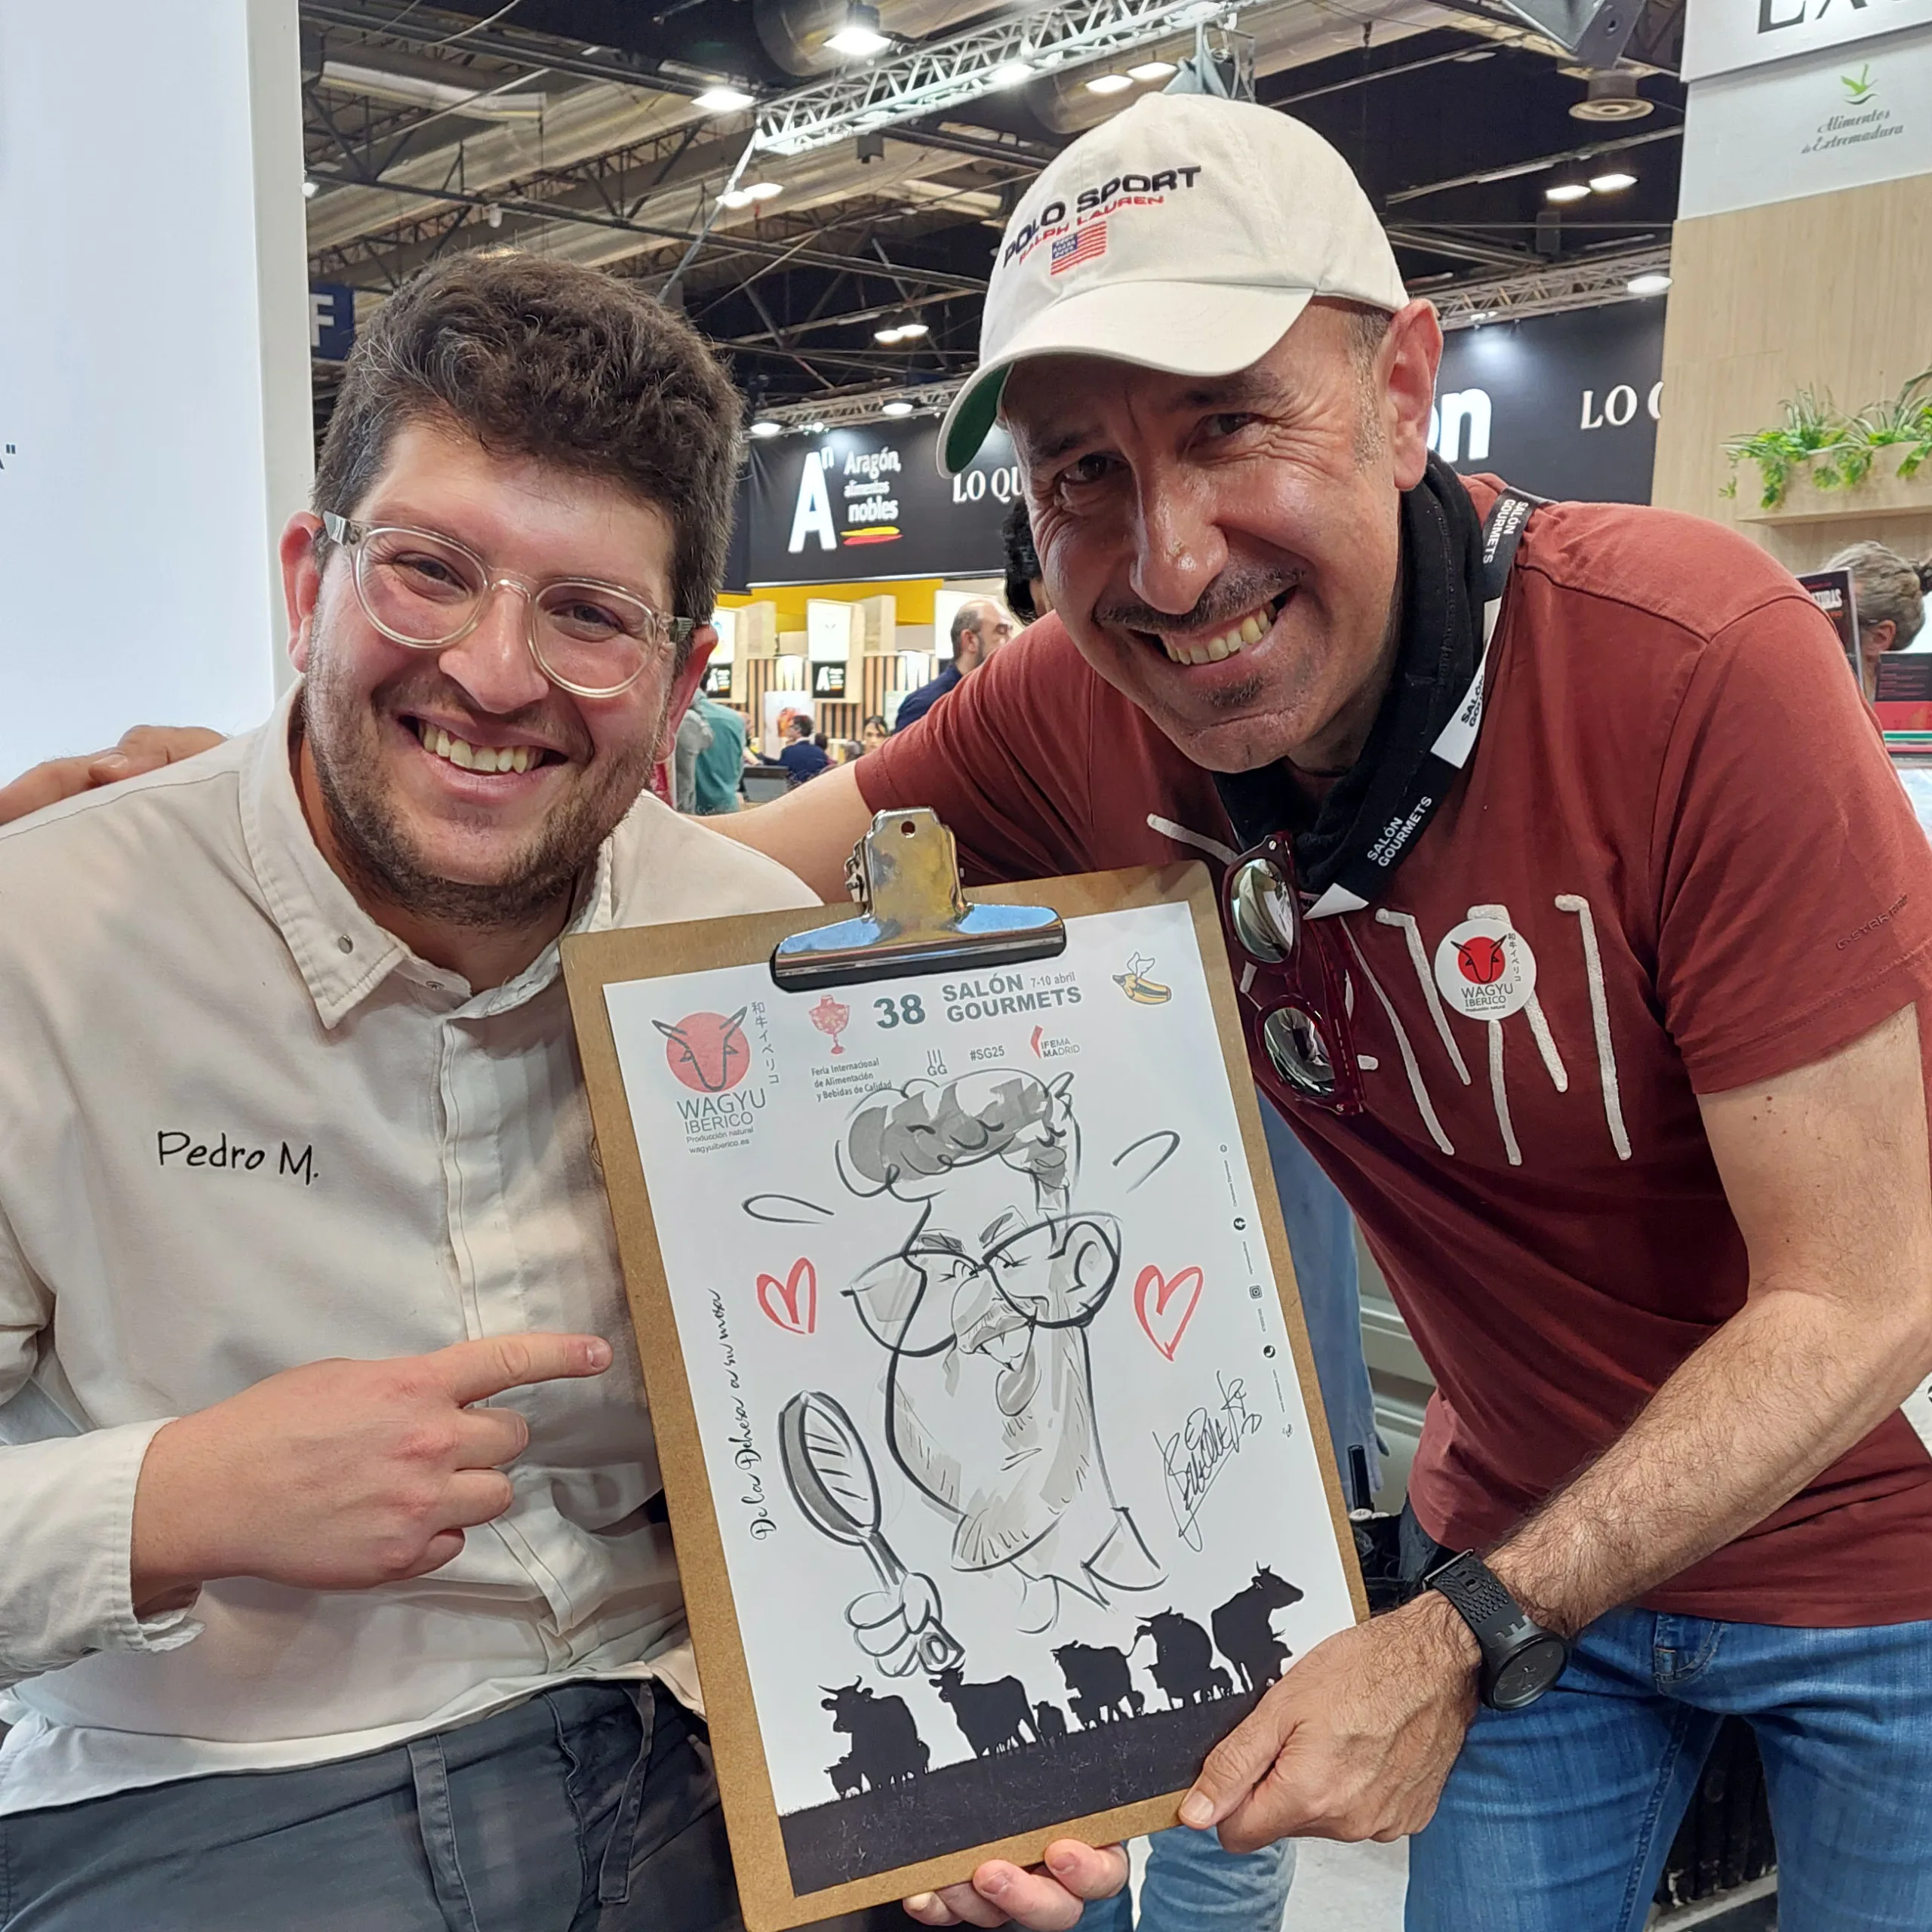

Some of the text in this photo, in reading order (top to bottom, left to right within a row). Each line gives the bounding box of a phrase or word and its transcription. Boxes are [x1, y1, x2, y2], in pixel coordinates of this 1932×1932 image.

[1003, 165, 1201, 268] POLO SPORT
[1019, 195, 1164, 266] RALPH LAUREN
[309, 293, 334, 347] F
[1580, 385, 1638, 430] LO
[843, 446, 902, 479] Aragón,
[952, 469, 986, 503] LO
[848, 495, 899, 522] nobles
[1503, 501, 1529, 535] SALÓN
[1482, 499, 1516, 565] GOURMETS
[1367, 817, 1404, 861] SALÓN
[1378, 796, 1432, 867] GOURMETS
[942, 971, 1075, 1002] SALÓN 7-10 abril
[1461, 983, 1513, 998] WAGYU
[1466, 995, 1506, 1008] IBERICO
[873, 994, 926, 1029] 38
[946, 986, 1082, 1023] GOURMETS
[970, 1045, 1005, 1061] #SG25
[1041, 1038, 1071, 1050] IFEMA
[1043, 1044, 1080, 1058] MADRID
[811, 1057, 880, 1076] Feria Internacional
[814, 1072, 874, 1088] de Alimentación
[677, 1088, 766, 1120] WAGYU
[823, 1088, 853, 1099] Bebidas
[854, 1084, 863, 1094] de
[865, 1080, 892, 1092] Calidad
[685, 1112, 753, 1134] IBERICO
[686, 1127, 754, 1144] Producción natural
[158, 1131, 319, 1186] Pedro M.
[750, 1506, 777, 1540] De
